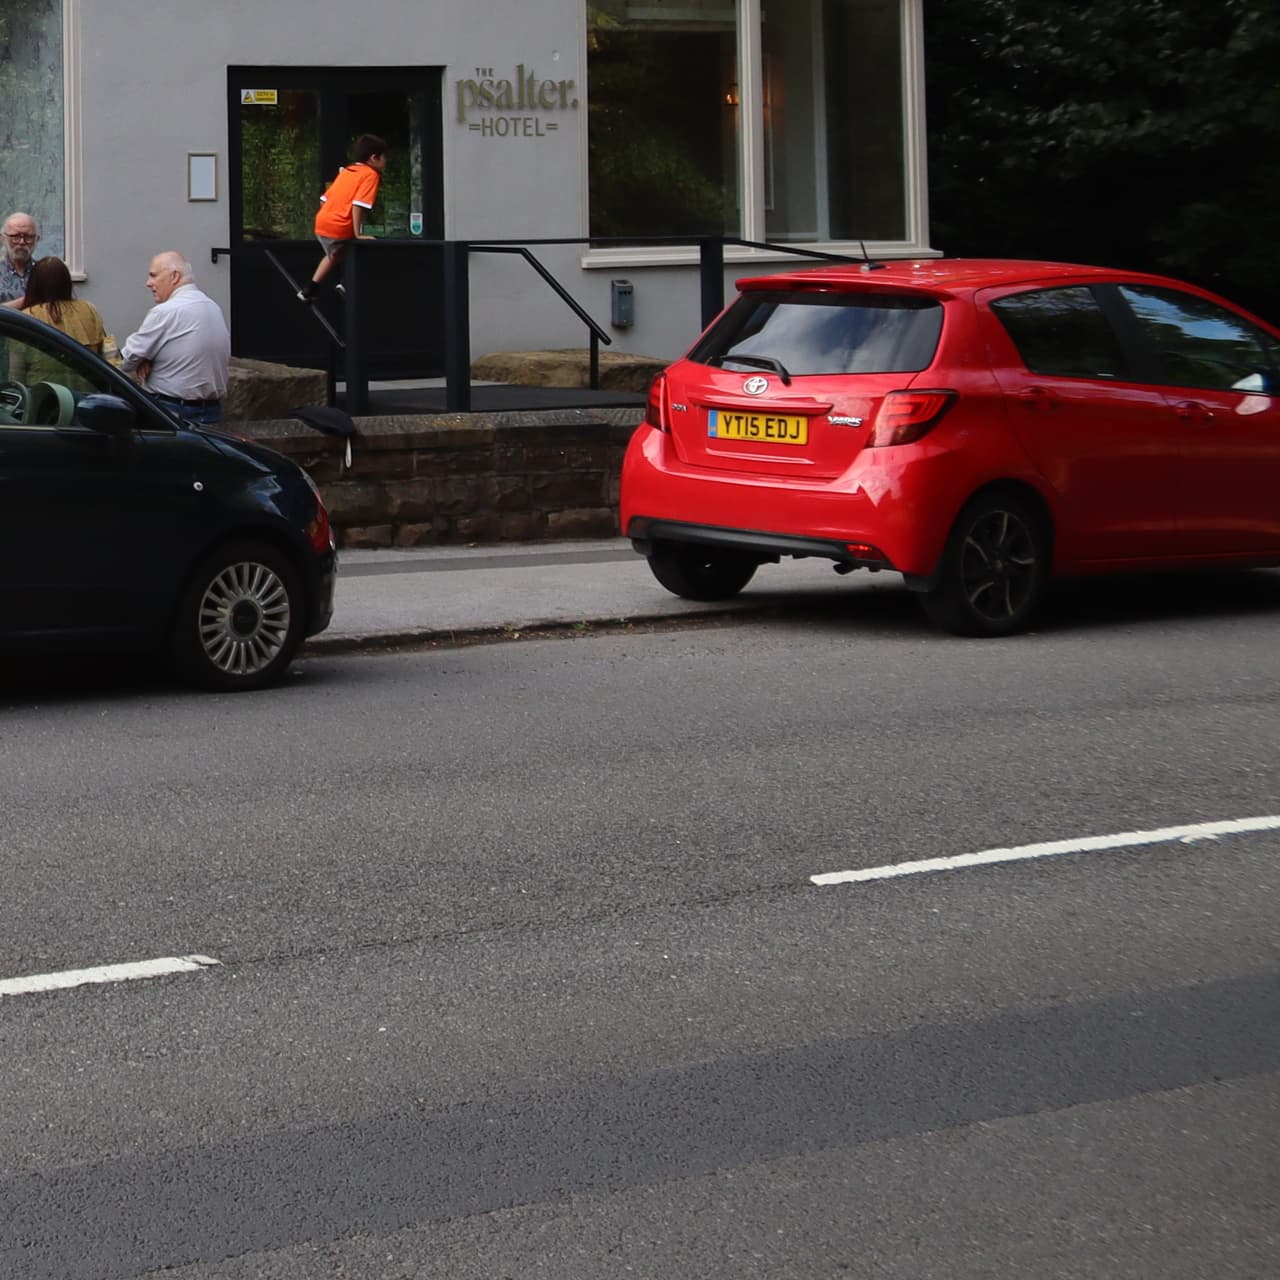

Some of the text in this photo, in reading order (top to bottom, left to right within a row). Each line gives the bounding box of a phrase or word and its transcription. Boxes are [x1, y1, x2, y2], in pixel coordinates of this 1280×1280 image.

[475, 66, 495, 78] THE
[456, 63, 579, 125] psalter.
[481, 117, 545, 137] HOTEL
[723, 414, 800, 440] YT15 EDJ
